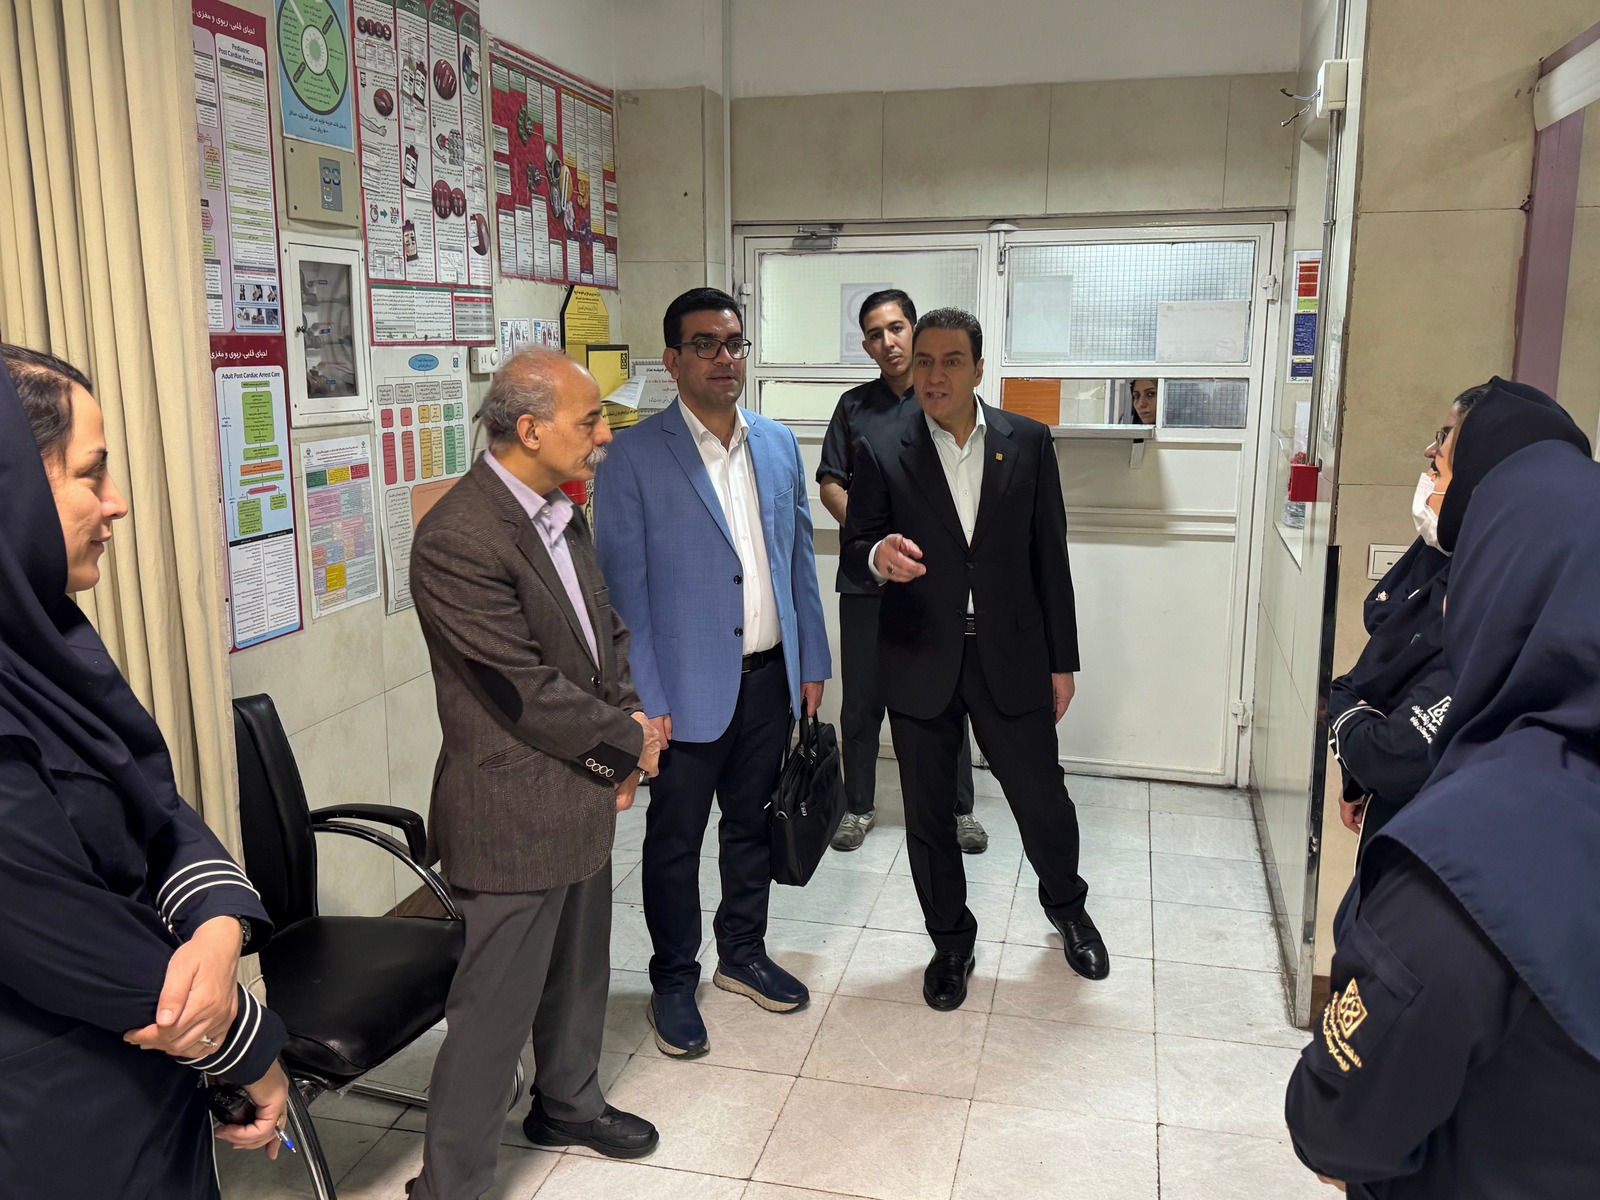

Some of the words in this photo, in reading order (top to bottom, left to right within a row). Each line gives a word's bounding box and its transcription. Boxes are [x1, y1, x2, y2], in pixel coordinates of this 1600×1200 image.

[196, 10, 211, 20] مغزی
[216, 18, 228, 26] ریوی
[243, 26, 256, 35] احیای
[232, 43, 250, 55] Pediatric
[219, 47, 227, 55] Post
[228, 50, 242, 59] Cardiac
[242, 53, 254, 63] Arrest
[254, 57, 263, 67] Care
[210, 350, 224, 359] مغزی
[255, 350, 268, 358] احیای
